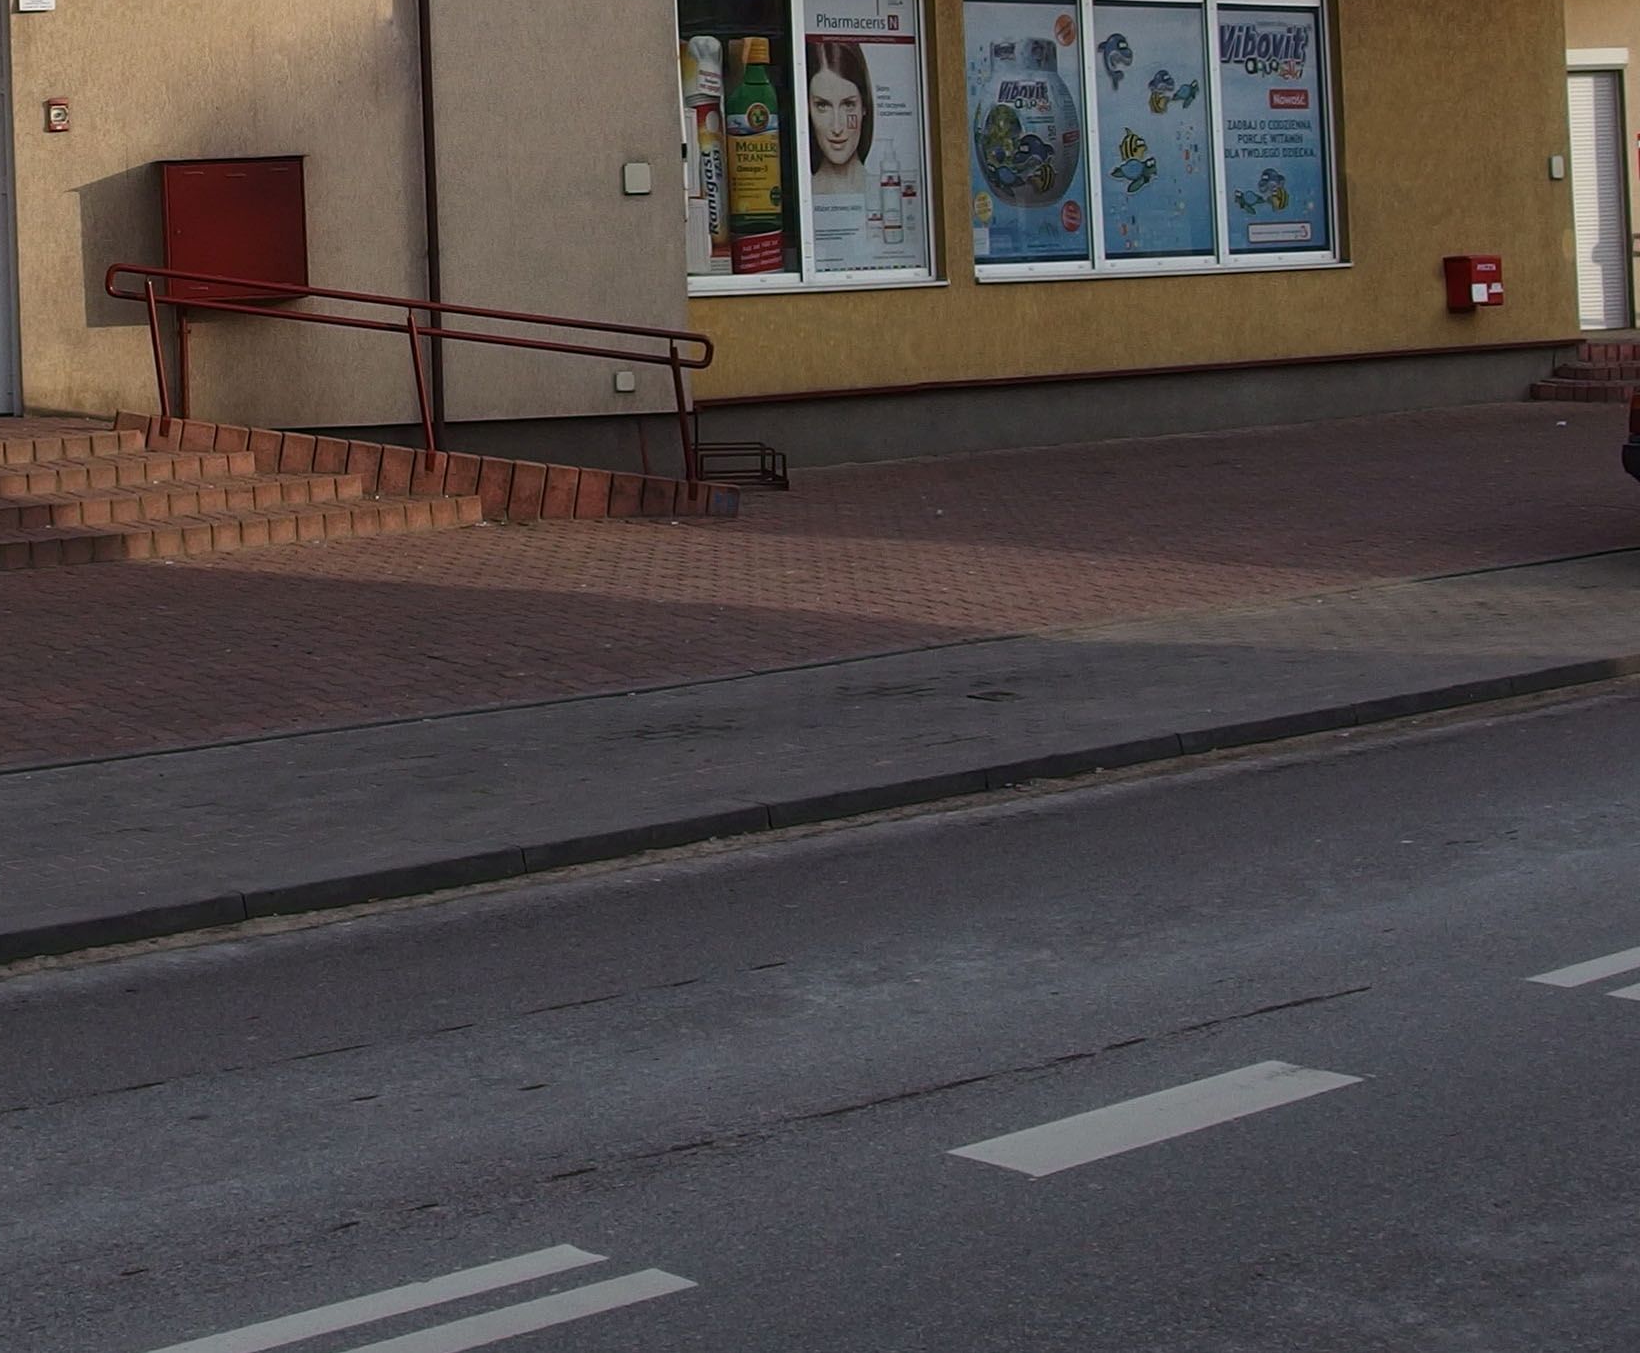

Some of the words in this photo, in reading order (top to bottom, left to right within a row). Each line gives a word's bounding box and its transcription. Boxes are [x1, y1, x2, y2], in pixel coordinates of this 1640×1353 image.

[816, 14, 886, 30] Pharmaceris
[1220, 24, 1307, 63] Vibovit
[998, 81, 1049, 103] Vibovit
[1227, 120, 1257, 130] ZADBAJ
[1259, 120, 1266, 130] O
[736, 153, 763, 162] TRAN
[1224, 148, 1240, 158] DLA
[701, 150, 719, 235] Ranigast
